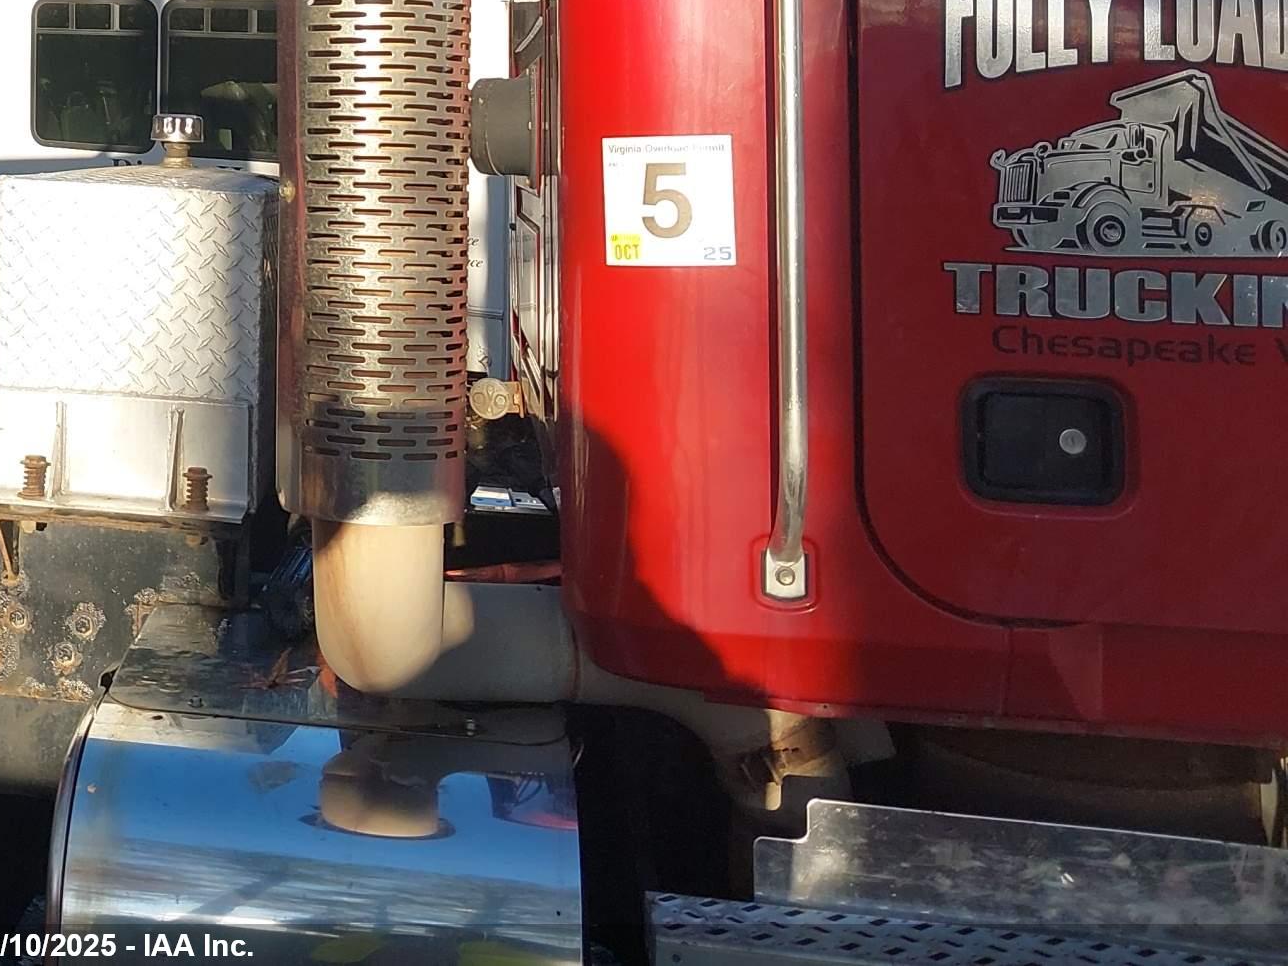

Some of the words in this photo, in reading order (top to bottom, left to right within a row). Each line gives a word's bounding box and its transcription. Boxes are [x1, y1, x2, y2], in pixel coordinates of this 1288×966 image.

[608, 144, 642, 156] Virginia
[692, 142, 725, 152] mit
[641, 162, 693, 239] 5
[614, 243, 641, 261] OCT
[703, 245, 733, 261] 25
[991, 325, 1257, 368] Chesapeake
